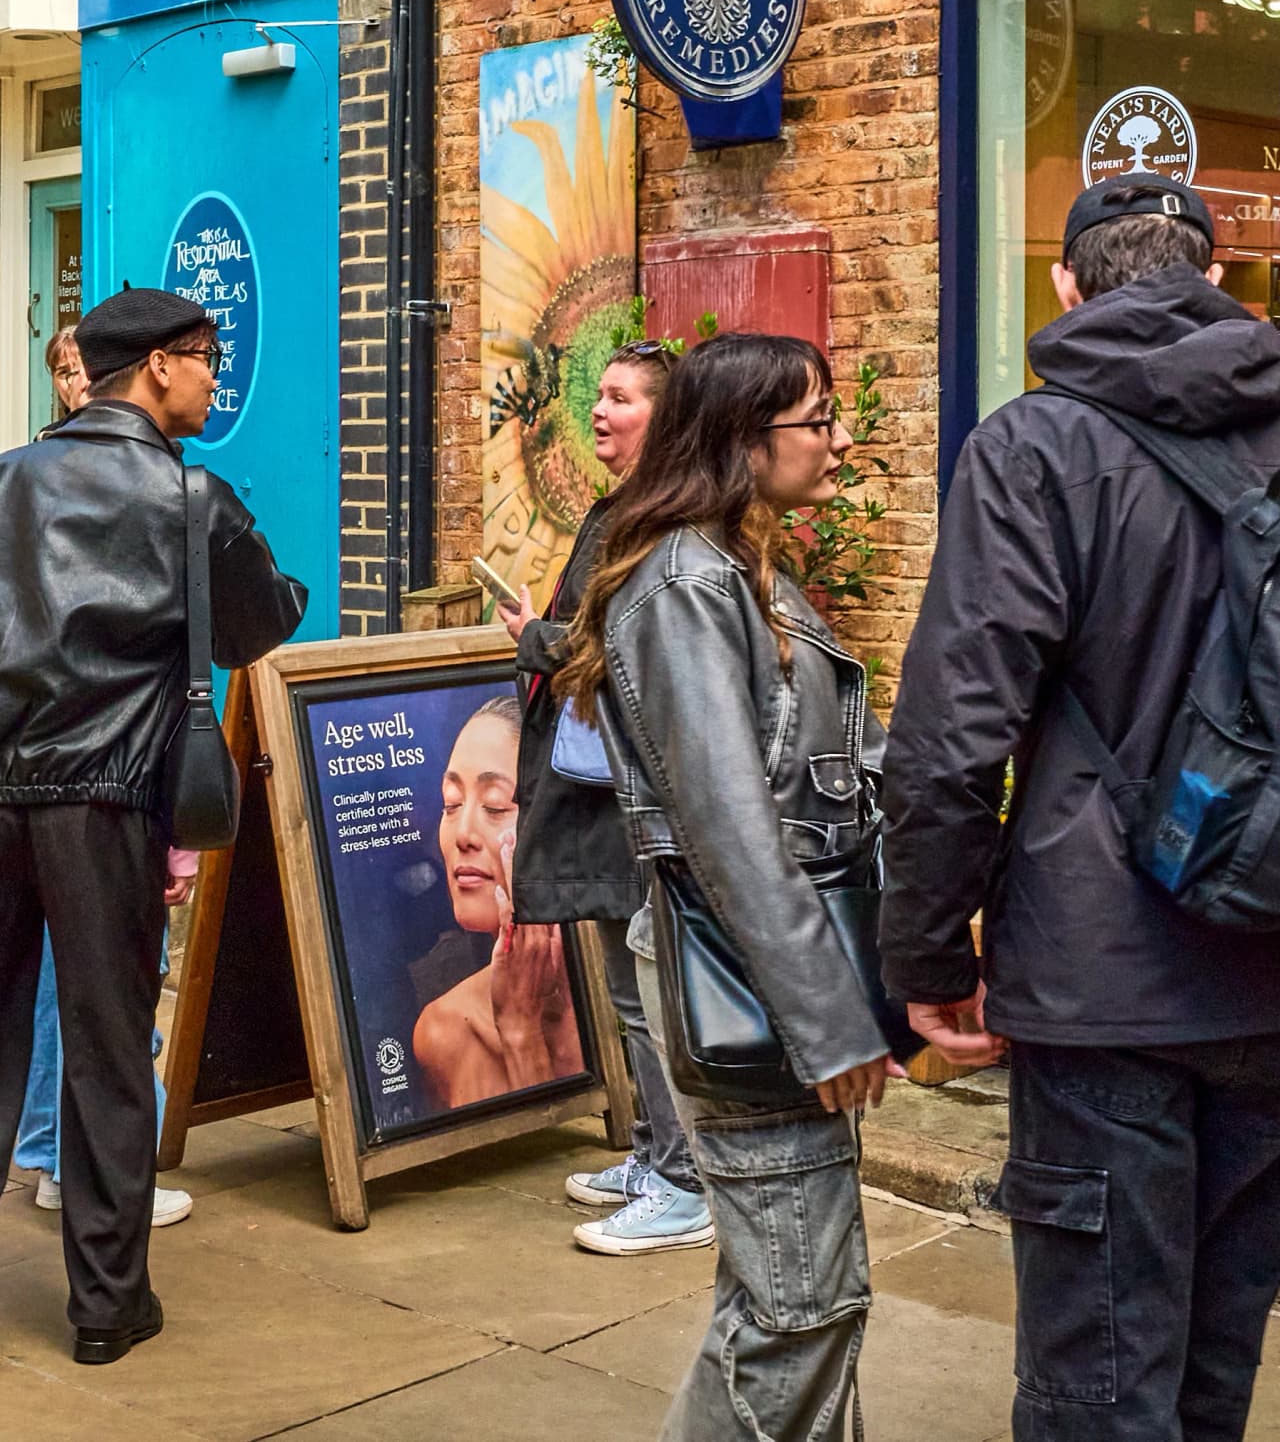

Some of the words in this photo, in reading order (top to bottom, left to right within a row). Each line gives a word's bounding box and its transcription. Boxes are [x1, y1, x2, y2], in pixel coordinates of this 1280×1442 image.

[1092, 97, 1144, 155] NEAL'S
[1149, 98, 1187, 148] YARD
[1091, 159, 1124, 171] COVENT
[1153, 153, 1188, 165] GARDEN
[174, 239, 250, 272] RESIDENTIAL
[192, 267, 224, 288] AREA
[214, 285, 230, 302] BE
[231, 282, 248, 303] AS
[324, 720, 365, 749] Age
[367, 712, 415, 739] well,
[328, 751, 386, 777] stress
[388, 744, 426, 768] less
[333, 790, 375, 807] Clinically
[377, 786, 414, 802] proven,
[335, 805, 376, 823] certified
[377, 800, 414, 816] organic
[338, 822, 378, 839] skincare
[379, 816, 402, 832] with
[402, 816, 410, 827] a
[340, 835, 391, 854] stress-less
[392, 830, 422, 846] secret
